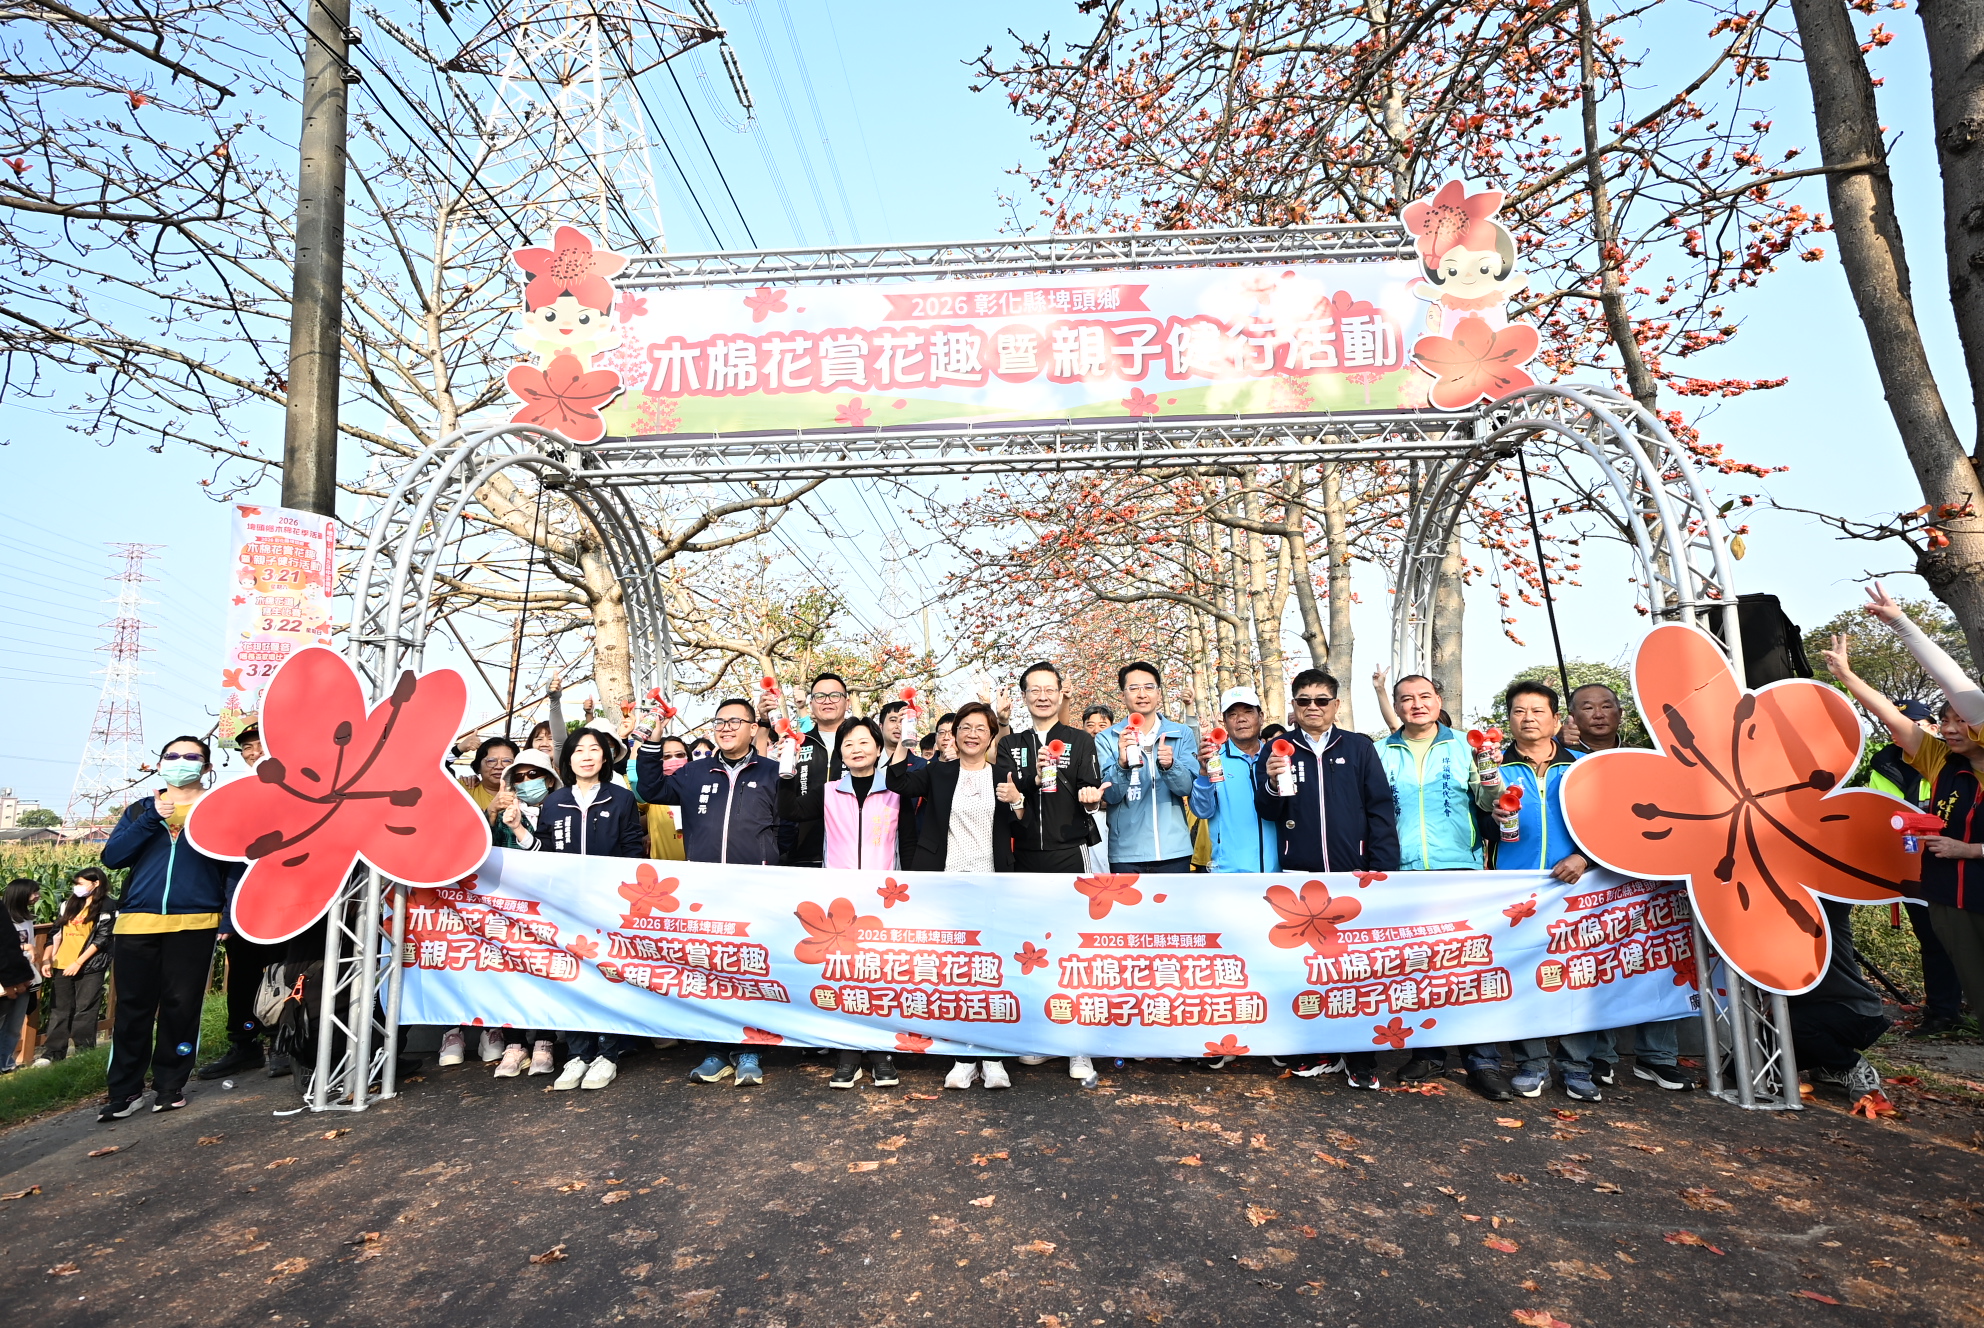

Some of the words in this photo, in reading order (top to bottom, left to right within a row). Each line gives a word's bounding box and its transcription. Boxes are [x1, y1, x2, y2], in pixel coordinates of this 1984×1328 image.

[911, 296, 968, 317] 2026
[974, 287, 1120, 315] 彰化縣埤頭鄉
[279, 517, 299, 526] 2026
[261, 568, 300, 583] 3/21
[262, 618, 302, 632] 3/22
[1577, 893, 1604, 908] 2026
[632, 917, 661, 930] 2026
[664, 918, 736, 935] 彰化縣埤頭鄉
[1337, 930, 1369, 944] 2026
[1372, 921, 1455, 943] 彰化縣埤頭鄉
[857, 929, 887, 942] 2026
[890, 929, 967, 946] 彰化縣埤頭鄉
[1093, 934, 1124, 948] 2026
[1127, 933, 1206, 948] 彰化縣埤頭鄉
[610, 934, 767, 974] 木棉花賞花趣
[1308, 937, 1491, 985] 木棉花賞花趣
[1541, 929, 1693, 988] 暨親子健行活
[825, 951, 1000, 987] 木棉花賞花趣
[1062, 958, 1246, 988] 木棉花賞花趣
